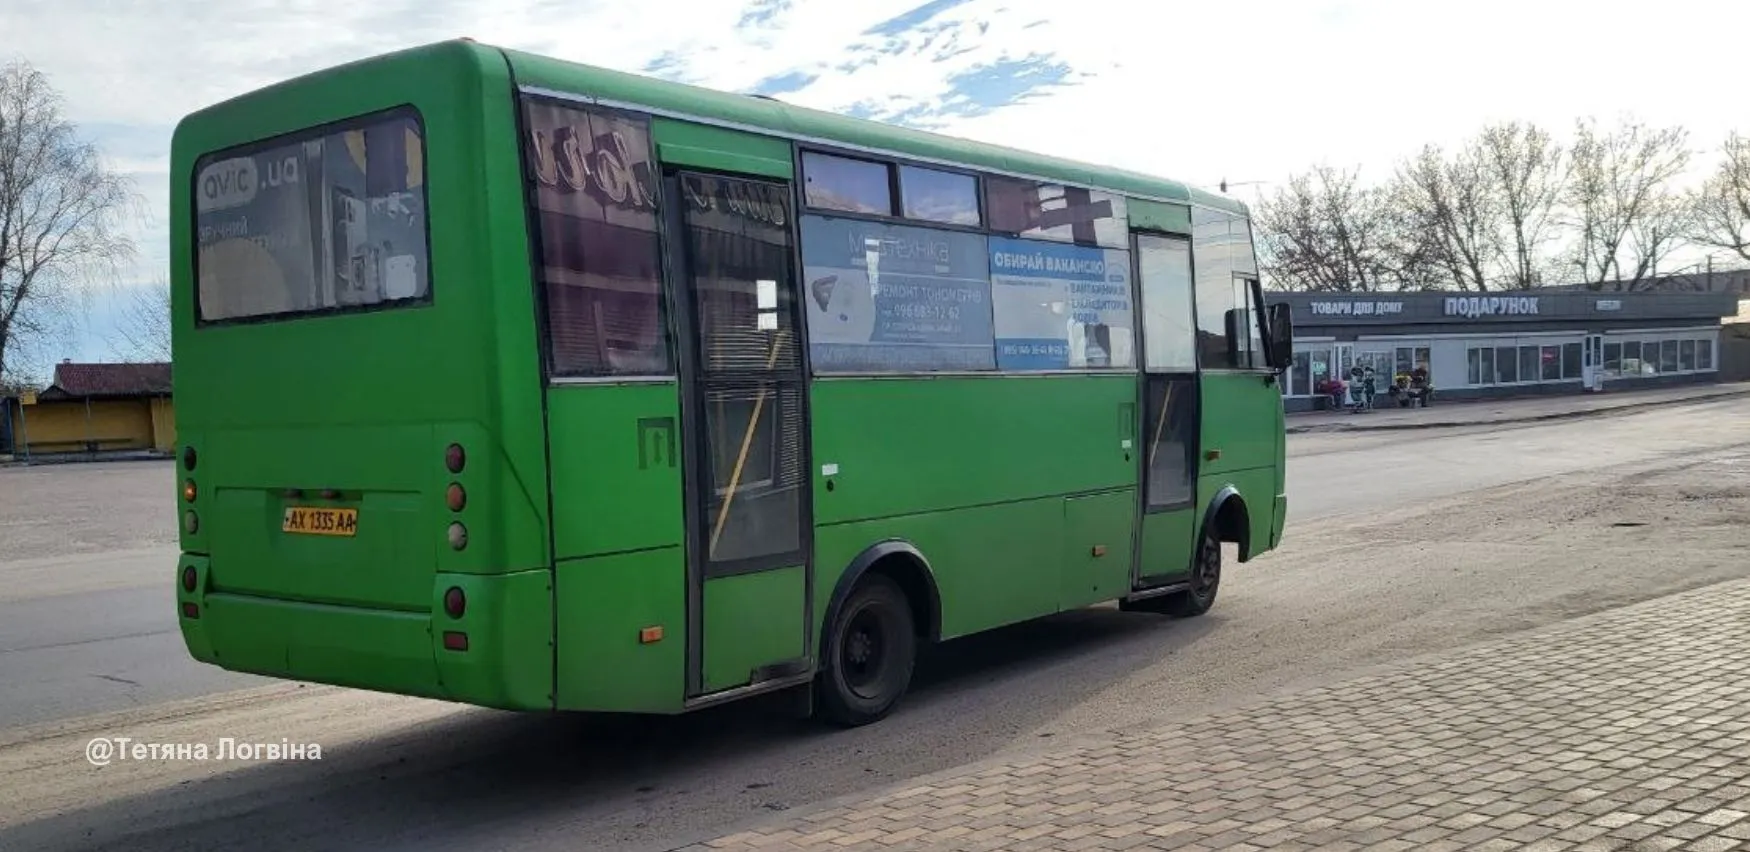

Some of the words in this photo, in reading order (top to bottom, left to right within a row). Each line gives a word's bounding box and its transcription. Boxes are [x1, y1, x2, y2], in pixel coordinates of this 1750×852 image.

[994, 251, 1044, 270] ОБИРАЙ
[880, 283, 918, 299] РЕМОНТ
[1310, 302, 1352, 314] ТОВАРИ
[1353, 302, 1374, 315] ДЛЯ
[1375, 302, 1403, 315] ДОМУ
[1444, 297, 1539, 318] ПОДАРУНОК
[291, 510, 305, 529] AX
[310, 511, 334, 531] 1335
[336, 511, 353, 533] AA
